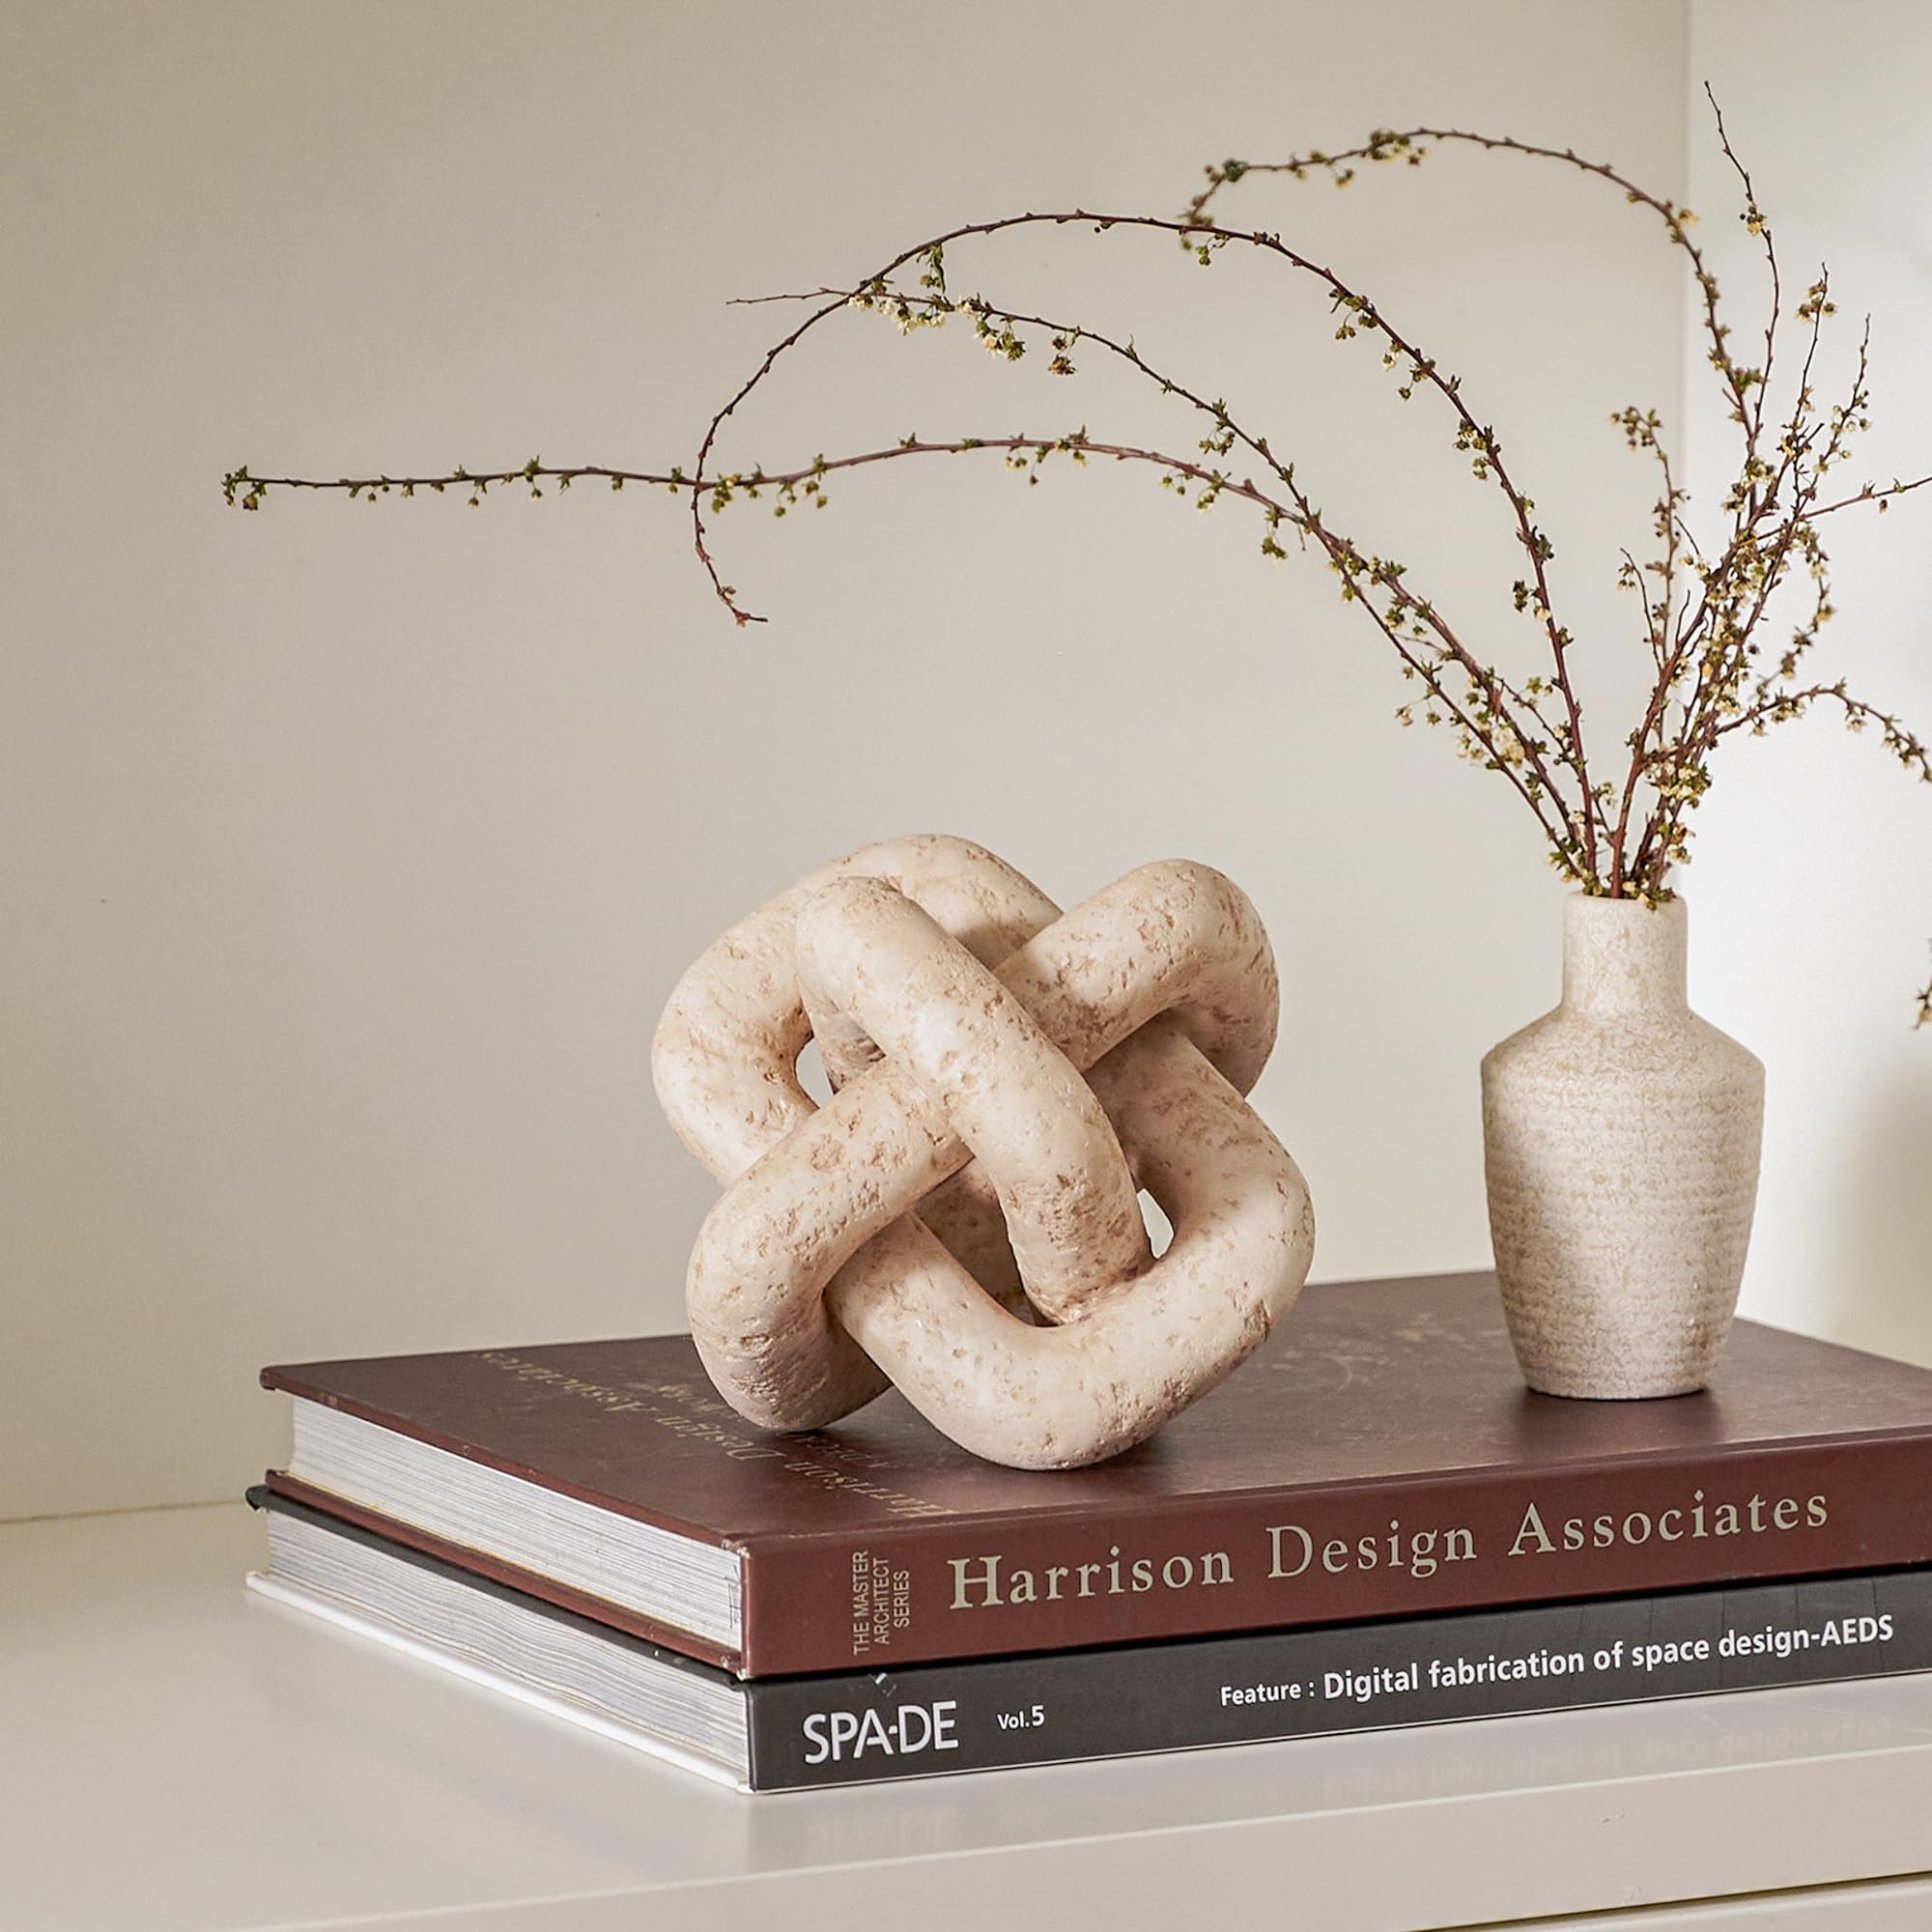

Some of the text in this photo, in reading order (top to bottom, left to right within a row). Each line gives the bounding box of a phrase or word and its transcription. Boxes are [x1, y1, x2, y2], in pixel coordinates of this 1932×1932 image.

[656, 1416, 786, 1461] Design
[784, 1462, 960, 1519] Harrison
[947, 1490, 1828, 1609] Harrison Design Associates
[852, 1550, 869, 1656] THE MASTER
[872, 1557, 890, 1645] ARCHITECT
[893, 1570, 910, 1628] SERIES
[1323, 1662, 1419, 1703] Digital
[1428, 1649, 1585, 1689] fabrication
[1593, 1640, 1624, 1671] of
[1631, 1639, 1710, 1672] space
[1718, 1613, 1894, 1659] design-AEDS
